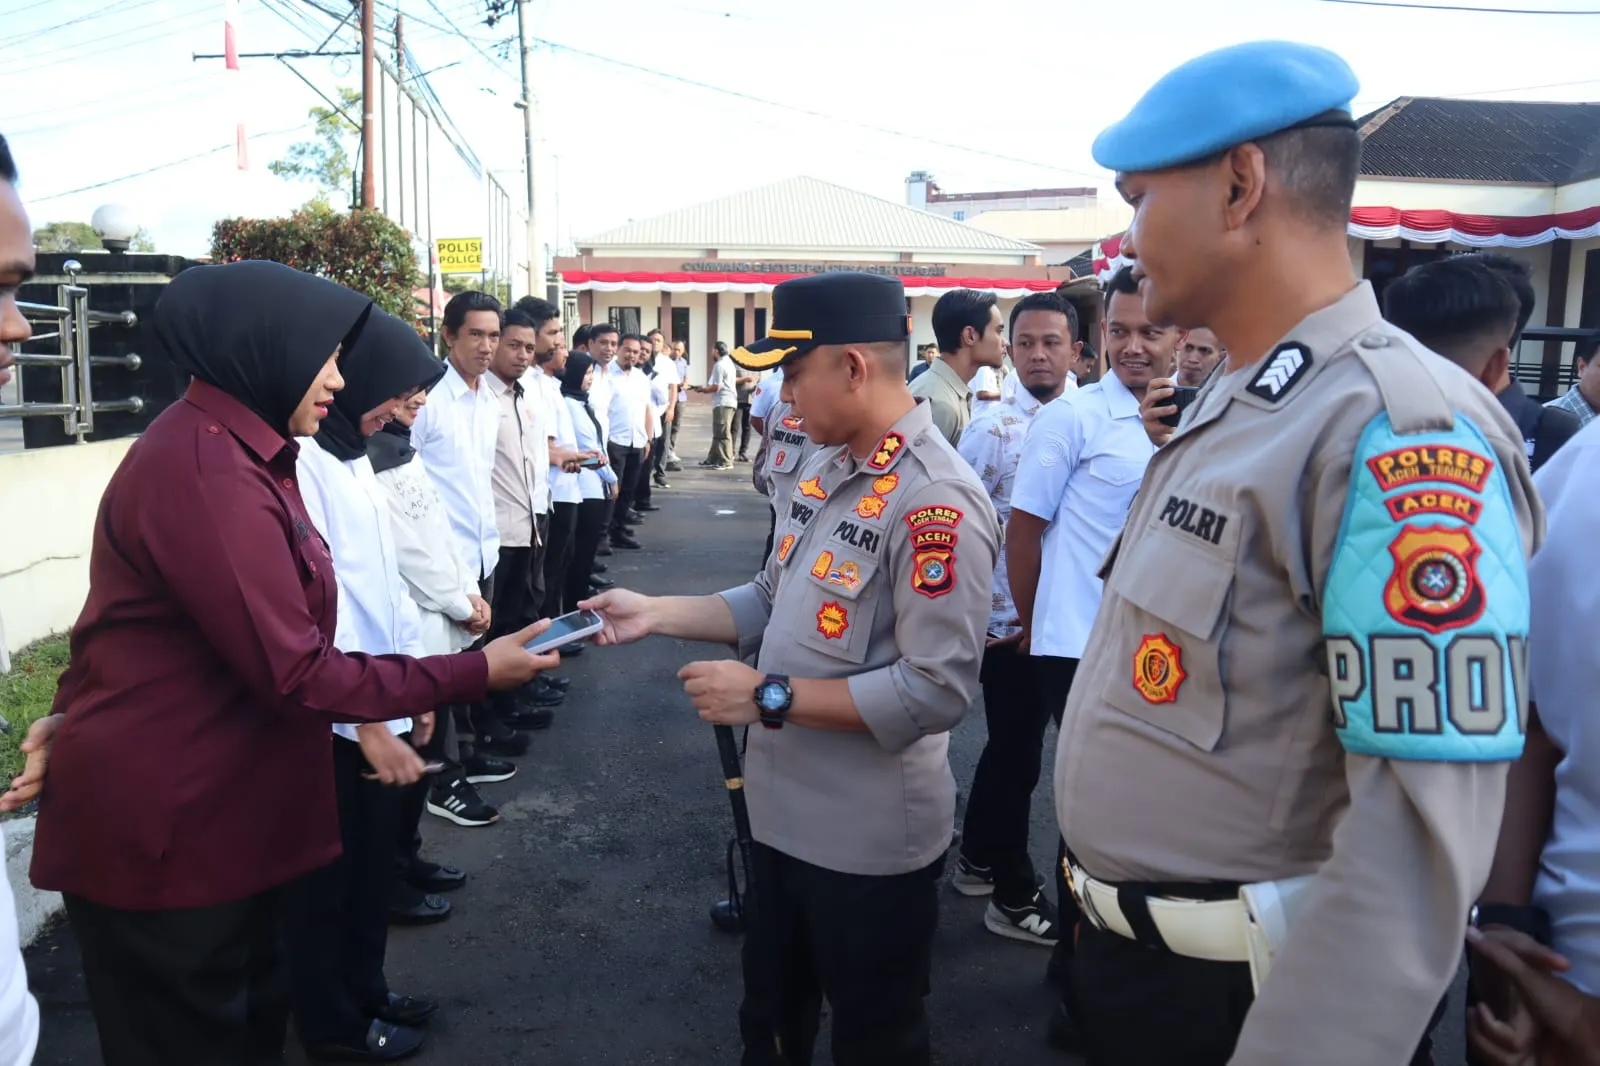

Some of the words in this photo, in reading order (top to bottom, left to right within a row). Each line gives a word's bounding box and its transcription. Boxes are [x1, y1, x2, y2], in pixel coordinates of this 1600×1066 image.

[438, 242, 482, 253] POLISI
[439, 255, 482, 264] POLICE
[682, 261, 750, 272] COMMAND
[752, 262, 804, 273] CENTER
[1377, 448, 1485, 475] POLRES
[1403, 494, 1471, 515] ACEH
[910, 508, 958, 522] POLRES
[1159, 495, 1227, 545] POLRI
[832, 520, 880, 554] POLRI
[917, 532, 951, 544] ACEH
